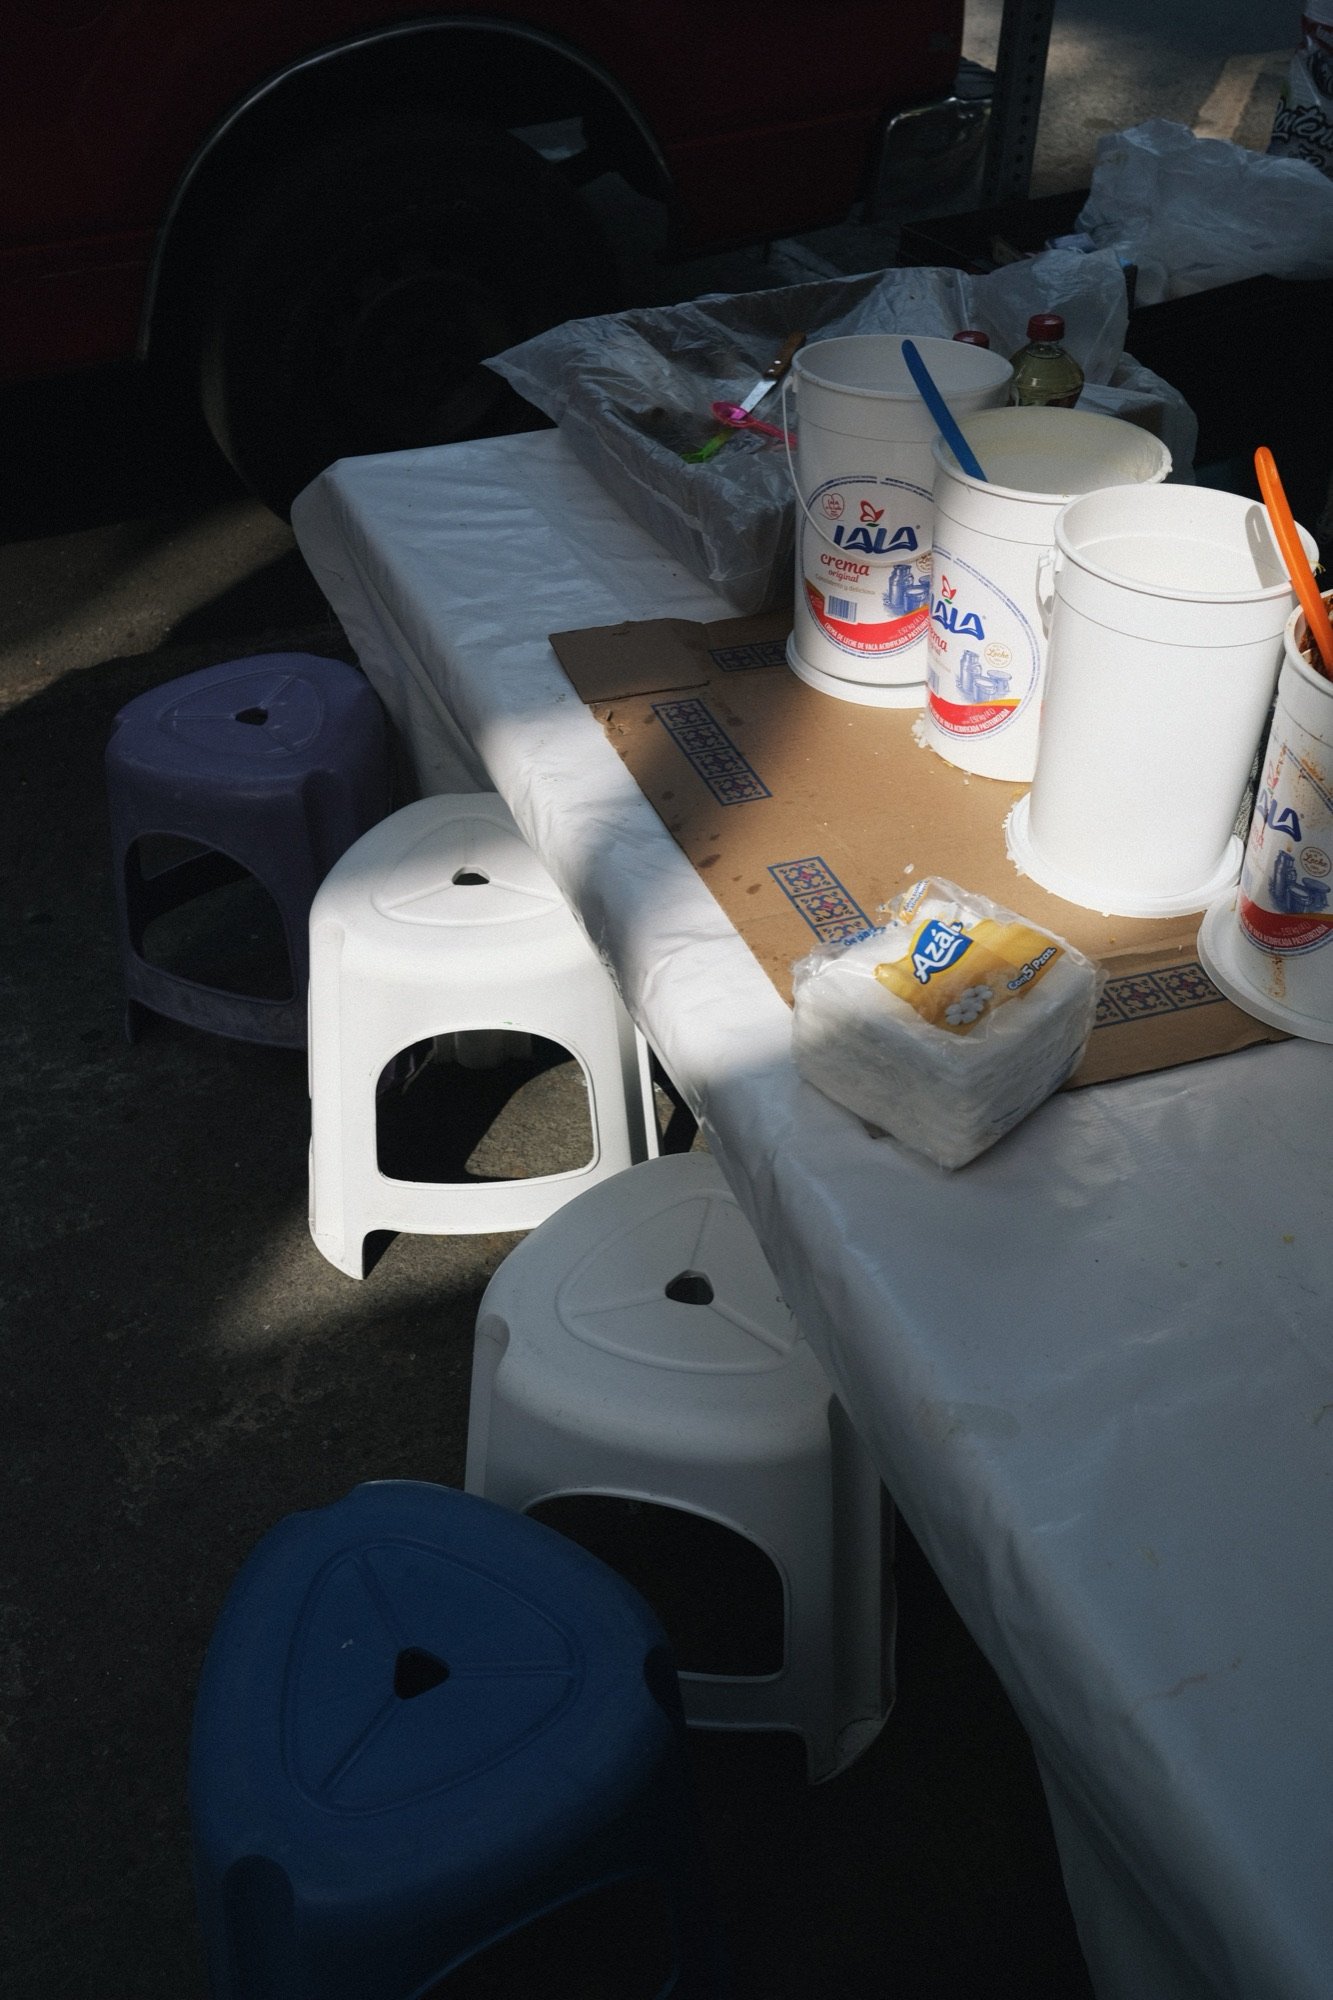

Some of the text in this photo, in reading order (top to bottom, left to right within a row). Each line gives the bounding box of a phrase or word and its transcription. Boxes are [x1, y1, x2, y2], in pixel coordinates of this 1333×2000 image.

[834, 525, 918, 554] LALA
[820, 553, 870, 576] crema
[828, 569, 859, 583] original
[930, 592, 985, 641] ALA
[1256, 788, 1302, 842] ALA
